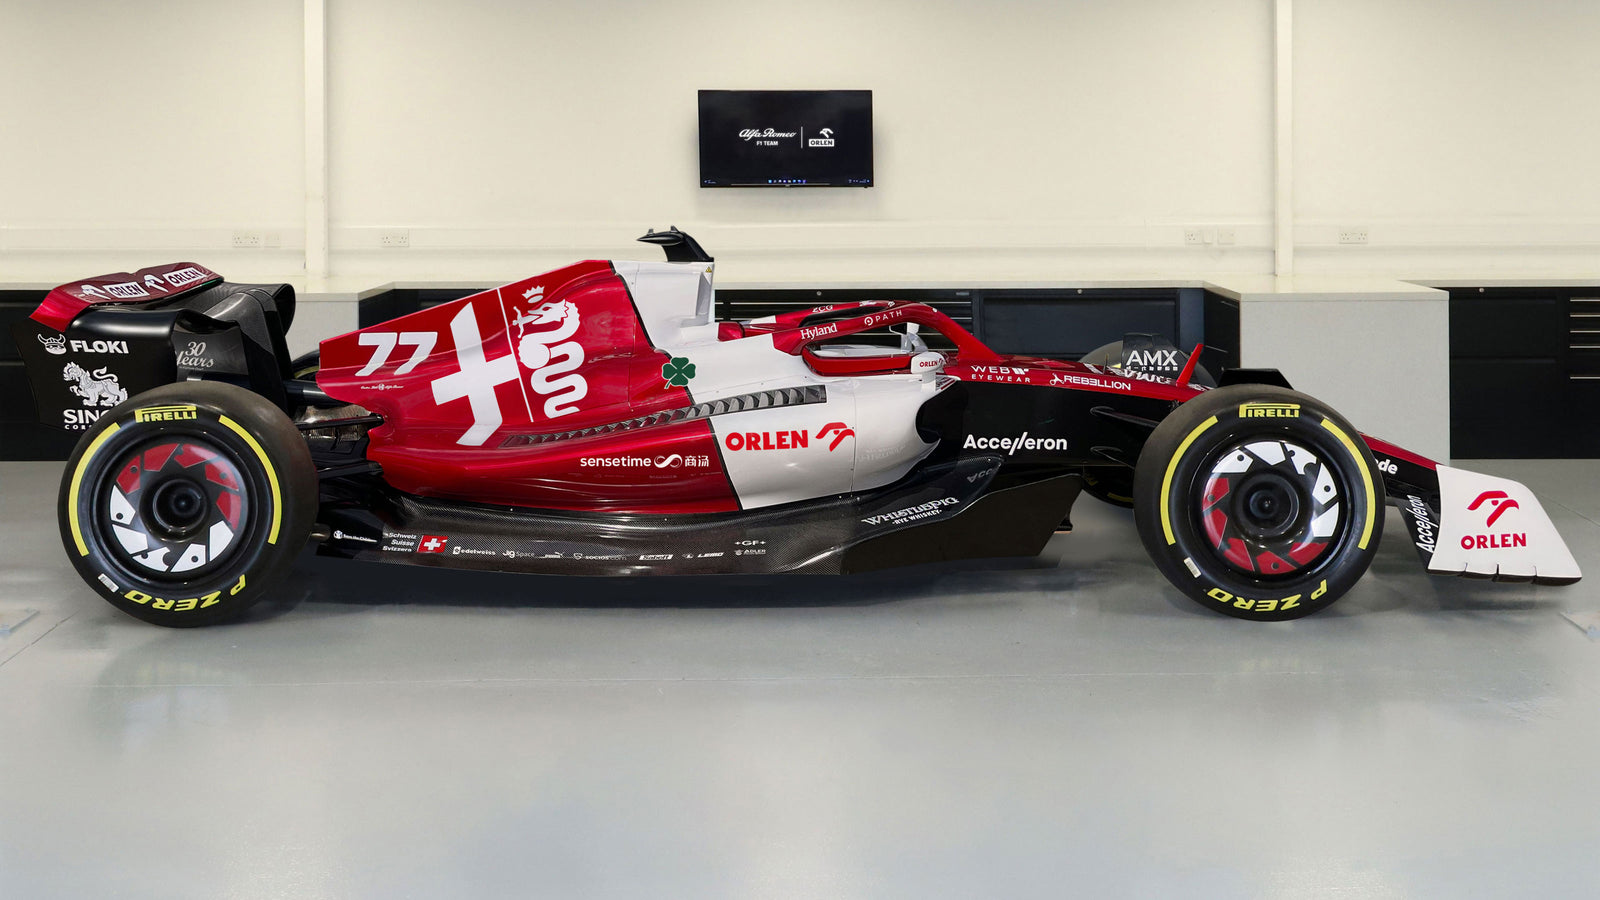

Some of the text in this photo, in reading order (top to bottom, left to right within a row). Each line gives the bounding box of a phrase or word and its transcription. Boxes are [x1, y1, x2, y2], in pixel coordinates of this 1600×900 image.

[739, 127, 797, 141] Alfa Romeo
[168, 269, 202, 283] ORLEN
[109, 283, 145, 297] ORLEN
[875, 310, 902, 322] PATH
[800, 322, 838, 340] Hyland
[70, 340, 129, 354] FLOKI
[187, 341, 207, 356] 30
[355, 332, 438, 376] 77
[1126, 350, 1178, 366] AMX
[970, 365, 1010, 374] WEB
[971, 374, 1031, 383] EYEWEAR
[1064, 375, 1131, 391] REBELLION
[134, 405, 197, 423] PIRELLI
[1239, 403, 1300, 418] PIRELLI
[725, 430, 809, 451] ORLEN
[963, 432, 1068, 456] Accelleron
[580, 455, 710, 467] sensetime 商汤
[1375, 459, 1398, 475] de
[389, 532, 417, 540] Schweiz
[391, 539, 415, 547] Suisse
[1460, 532, 1527, 550] ORLEN
[461, 548, 496, 556] edelweiss
[124, 574, 246, 612] P ZERO
[1207, 579, 1328, 612] P ZERO
